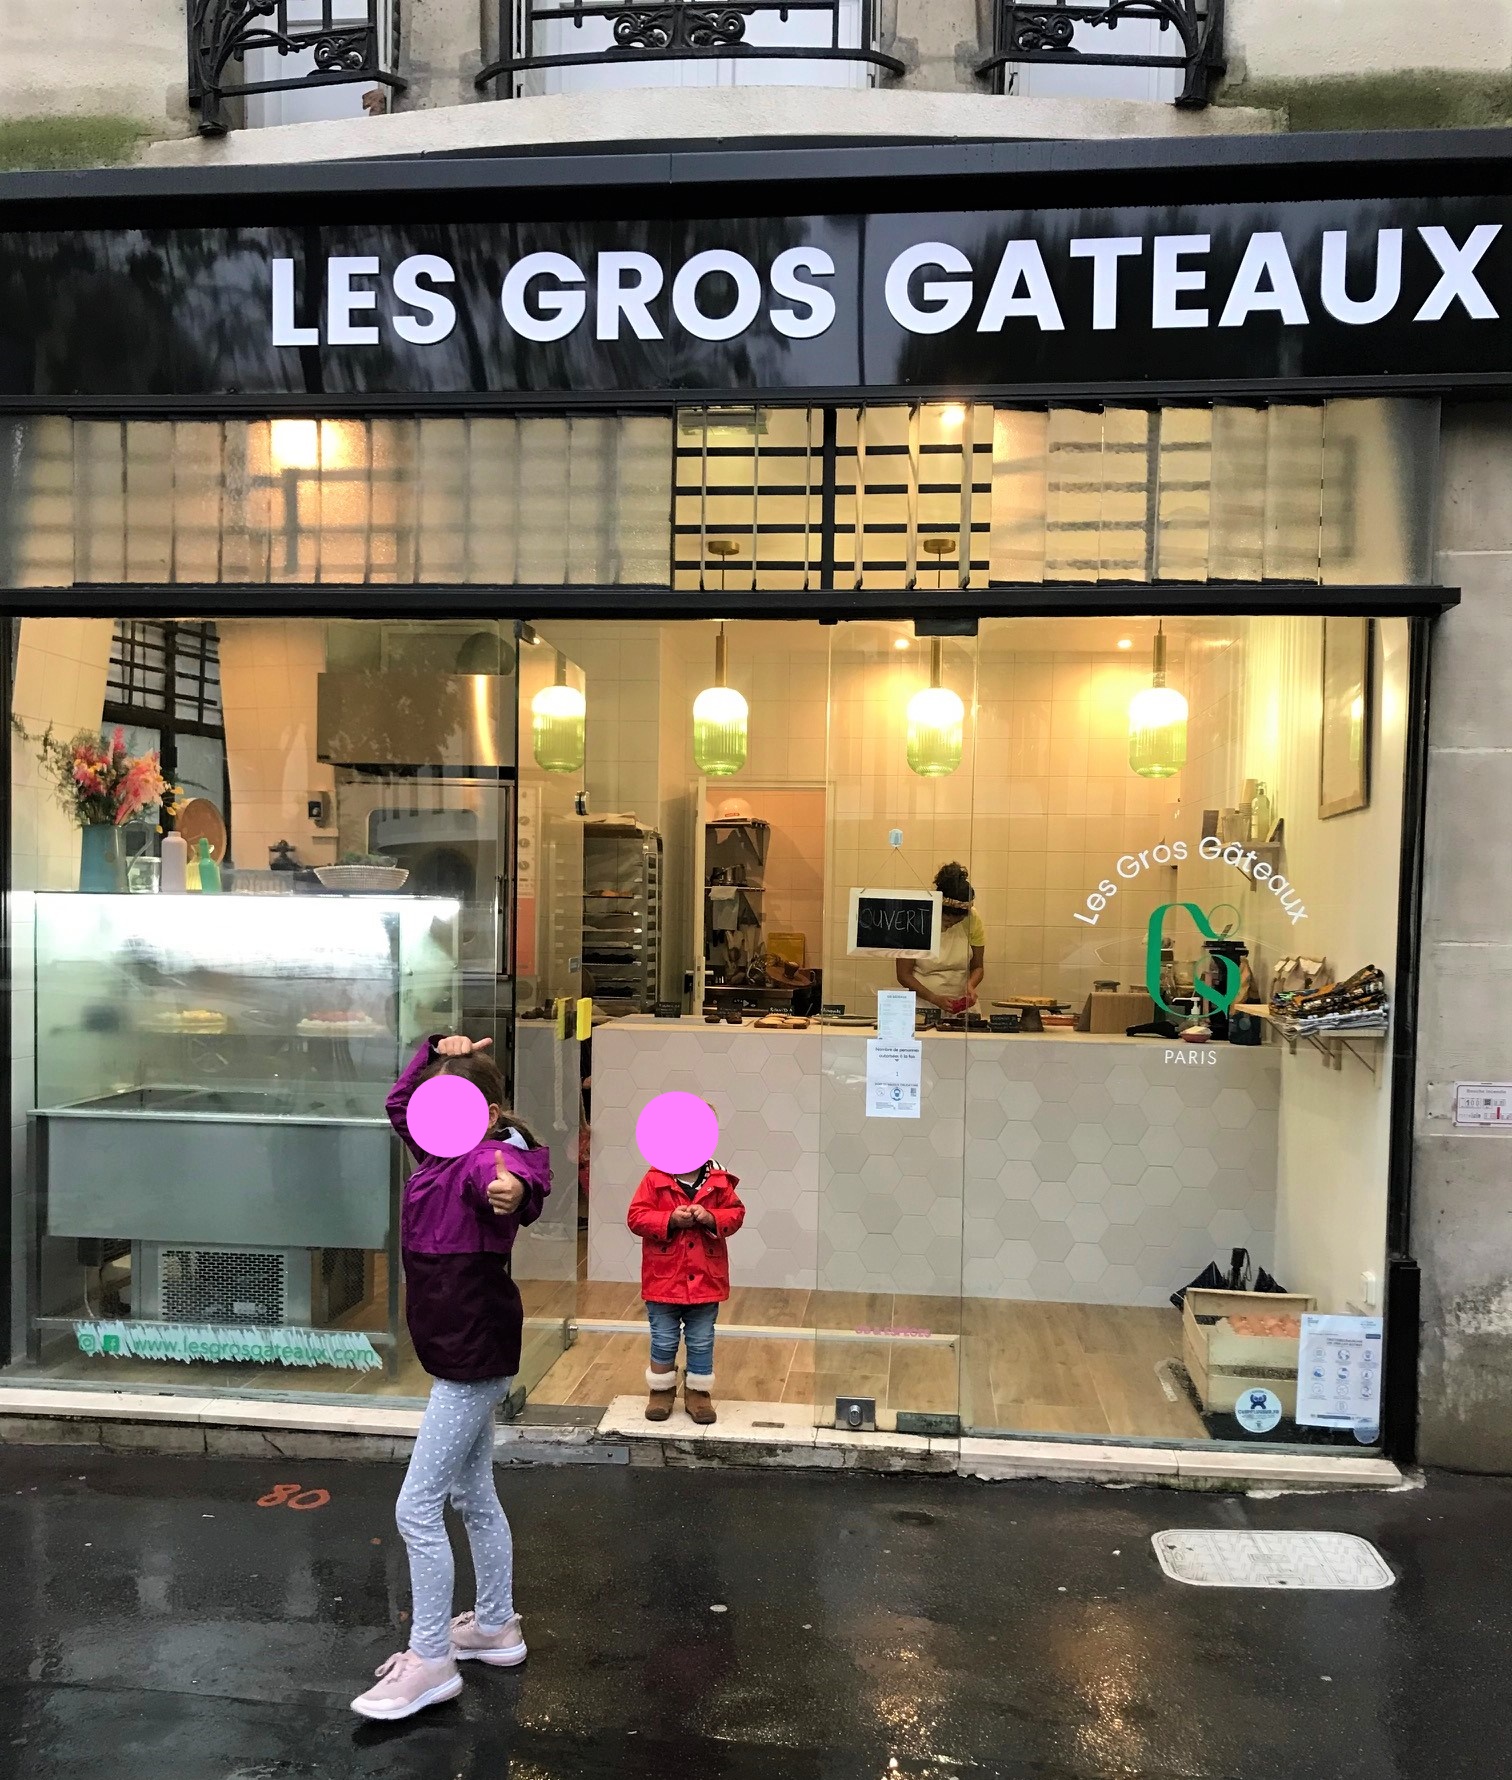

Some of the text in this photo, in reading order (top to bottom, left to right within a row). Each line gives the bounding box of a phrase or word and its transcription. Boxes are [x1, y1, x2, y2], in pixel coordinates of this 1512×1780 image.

[272, 225, 1503, 346] LES GROS GATEAUX
[1073, 836, 1309, 925] Les Gros Gâteaux
[859, 907, 930, 935] OUVERT
[1164, 1050, 1217, 1065] PARIS
[133, 1336, 374, 1361] www.lesgrosgateaux.com
[256, 1484, 331, 1510] 80
